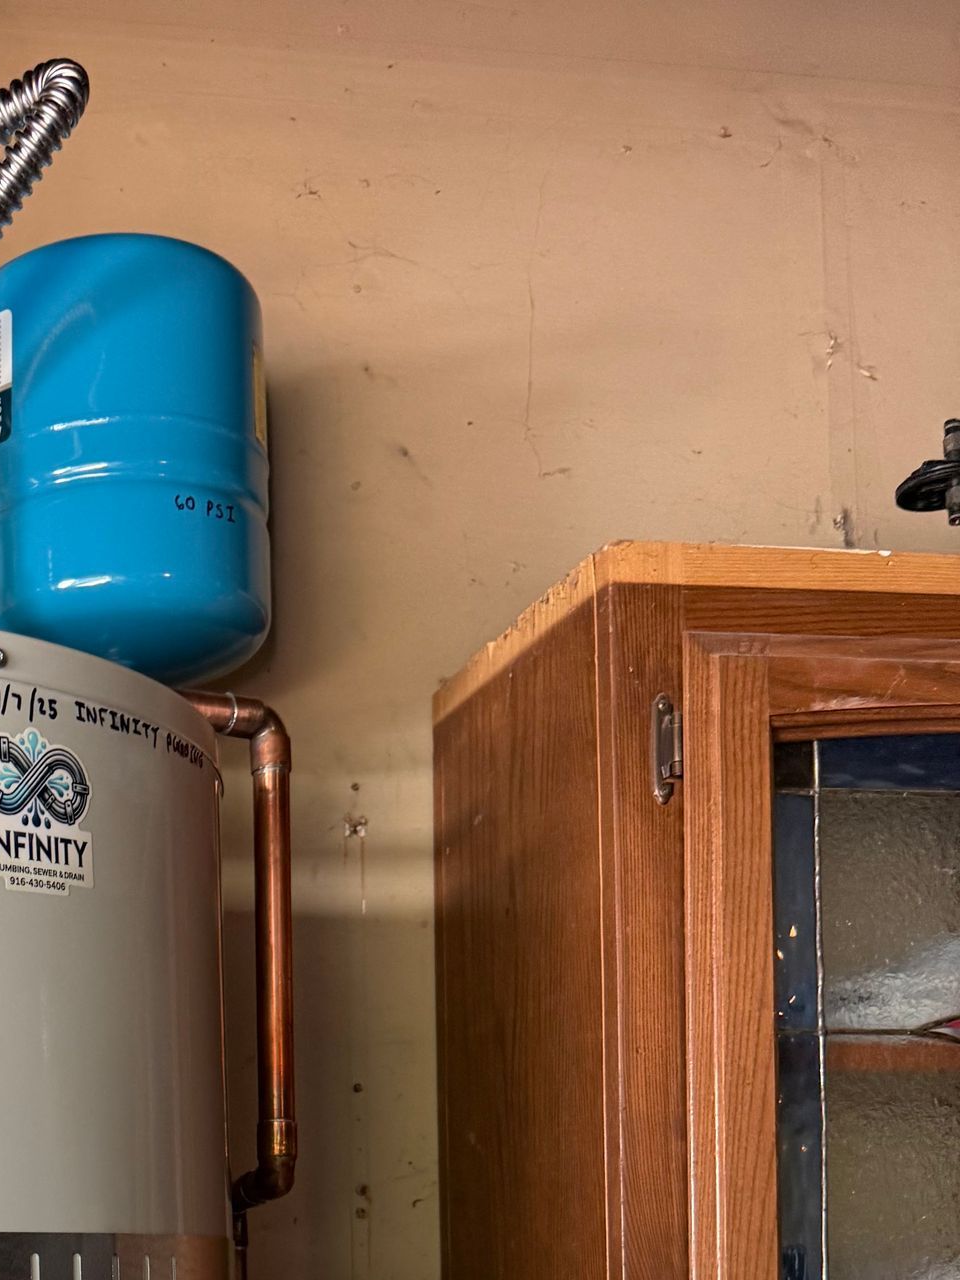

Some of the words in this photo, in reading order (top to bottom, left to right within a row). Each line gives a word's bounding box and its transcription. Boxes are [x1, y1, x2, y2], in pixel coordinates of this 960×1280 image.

[174, 494, 195, 511] 60
[207, 496, 236, 522] PSI
[74, 701, 160, 748] INFINITY
[33, 867, 58, 878] SEWER
[10, 876, 66, 891] 916-430-5406
